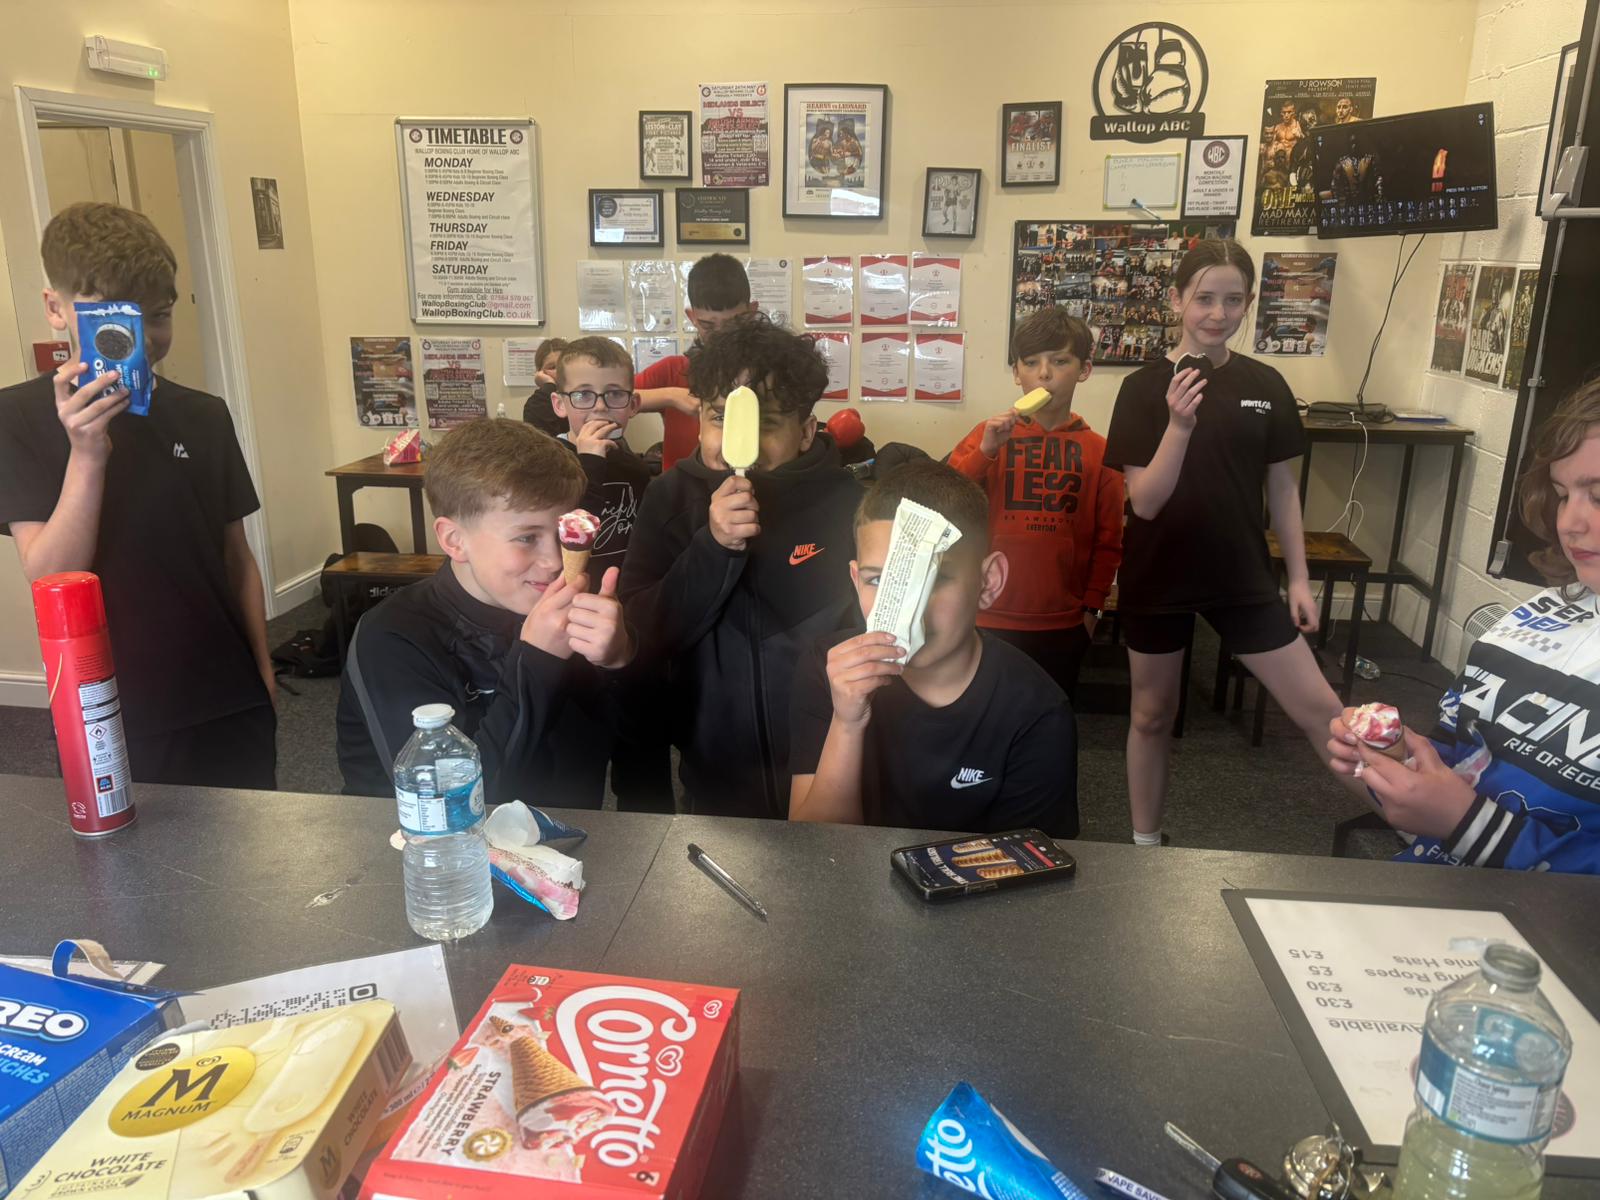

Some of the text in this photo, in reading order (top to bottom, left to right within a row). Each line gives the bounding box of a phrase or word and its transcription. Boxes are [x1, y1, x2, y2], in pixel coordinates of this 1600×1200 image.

[1309, 80, 1343, 88] ROWSON
[1104, 120, 1191, 134] Wallop ABC
[425, 127, 507, 145] TIMETABLE
[1011, 141, 1052, 152] FINALIST
[424, 157, 473, 168] MONDAY
[426, 191, 495, 202] WEDNESDAY
[1260, 209, 1283, 219] MAD
[1284, 208, 1308, 218] MAX
[429, 222, 488, 233] THURSDAY
[1258, 217, 1314, 226] RETIREMEN
[430, 240, 469, 251] FRIDAY
[432, 264, 489, 275] SATURDAY
[421, 308, 532, 319] WallopBoxingClub.co.uk
[1006, 436, 1083, 473] FEAR
[794, 543, 816, 556] NIKE
[1535, 750, 1563, 767] OF
[957, 767, 985, 782] NIKE
[1288, 948, 1325, 961] £15
[1392, 955, 1440, 968] Hats
[1308, 965, 1334, 977] £5
[1364, 967, 1432, 983] Ropes
[1306, 980, 1343, 993] £30
[1315, 996, 1353, 1009] £30
[0, 1000, 84, 1037] REO
[1328, 1018, 1424, 1036] Available
[0, 1044, 47, 1066] CREAM
[556, 985, 697, 1168] Cornetto
[137, 1062, 229, 1109] M
[121, 1101, 213, 1121] MAGNUM
[443, 1071, 502, 1156] STRAWBERRY
[90, 1151, 152, 1167] WHITE
[54, 1160, 167, 1183] CHOCOLATE
[636, 1169, 655, 1183] 6
[1107, 1174, 1135, 1192] VAPE
